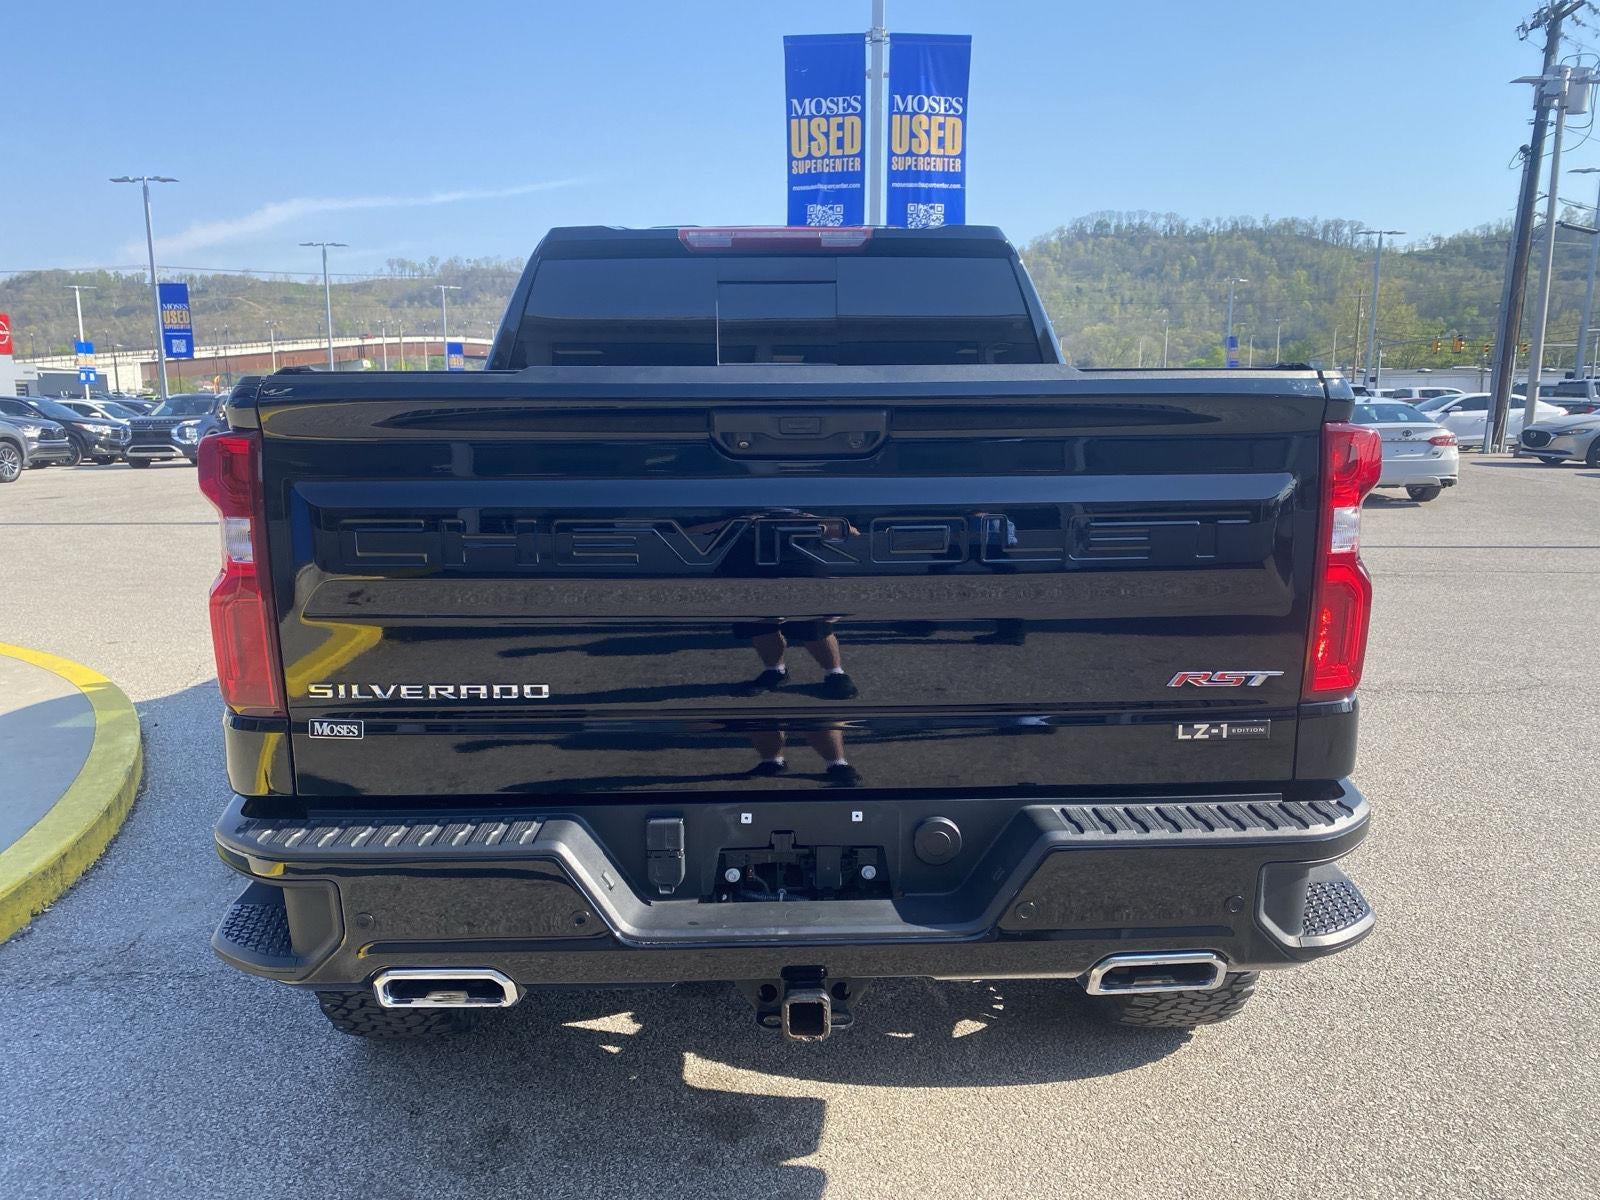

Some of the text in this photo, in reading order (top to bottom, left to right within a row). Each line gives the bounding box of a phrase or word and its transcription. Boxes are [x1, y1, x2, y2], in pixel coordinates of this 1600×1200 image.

[790, 95, 862, 117] MOSES
[892, 94, 964, 115] MOSES
[790, 115, 862, 159] USED
[891, 114, 963, 156] USED
[791, 158, 861, 174] SUPERCENTER
[891, 156, 962, 173] SUPERCENTER
[163, 310, 190, 324] USED
[337, 511, 1252, 567] CHEVROLET
[1166, 671, 1285, 688] RST
[307, 683, 550, 700] SILVERADO
[313, 721, 358, 737] MOSES
[1177, 723, 1229, 740] LZ-1
